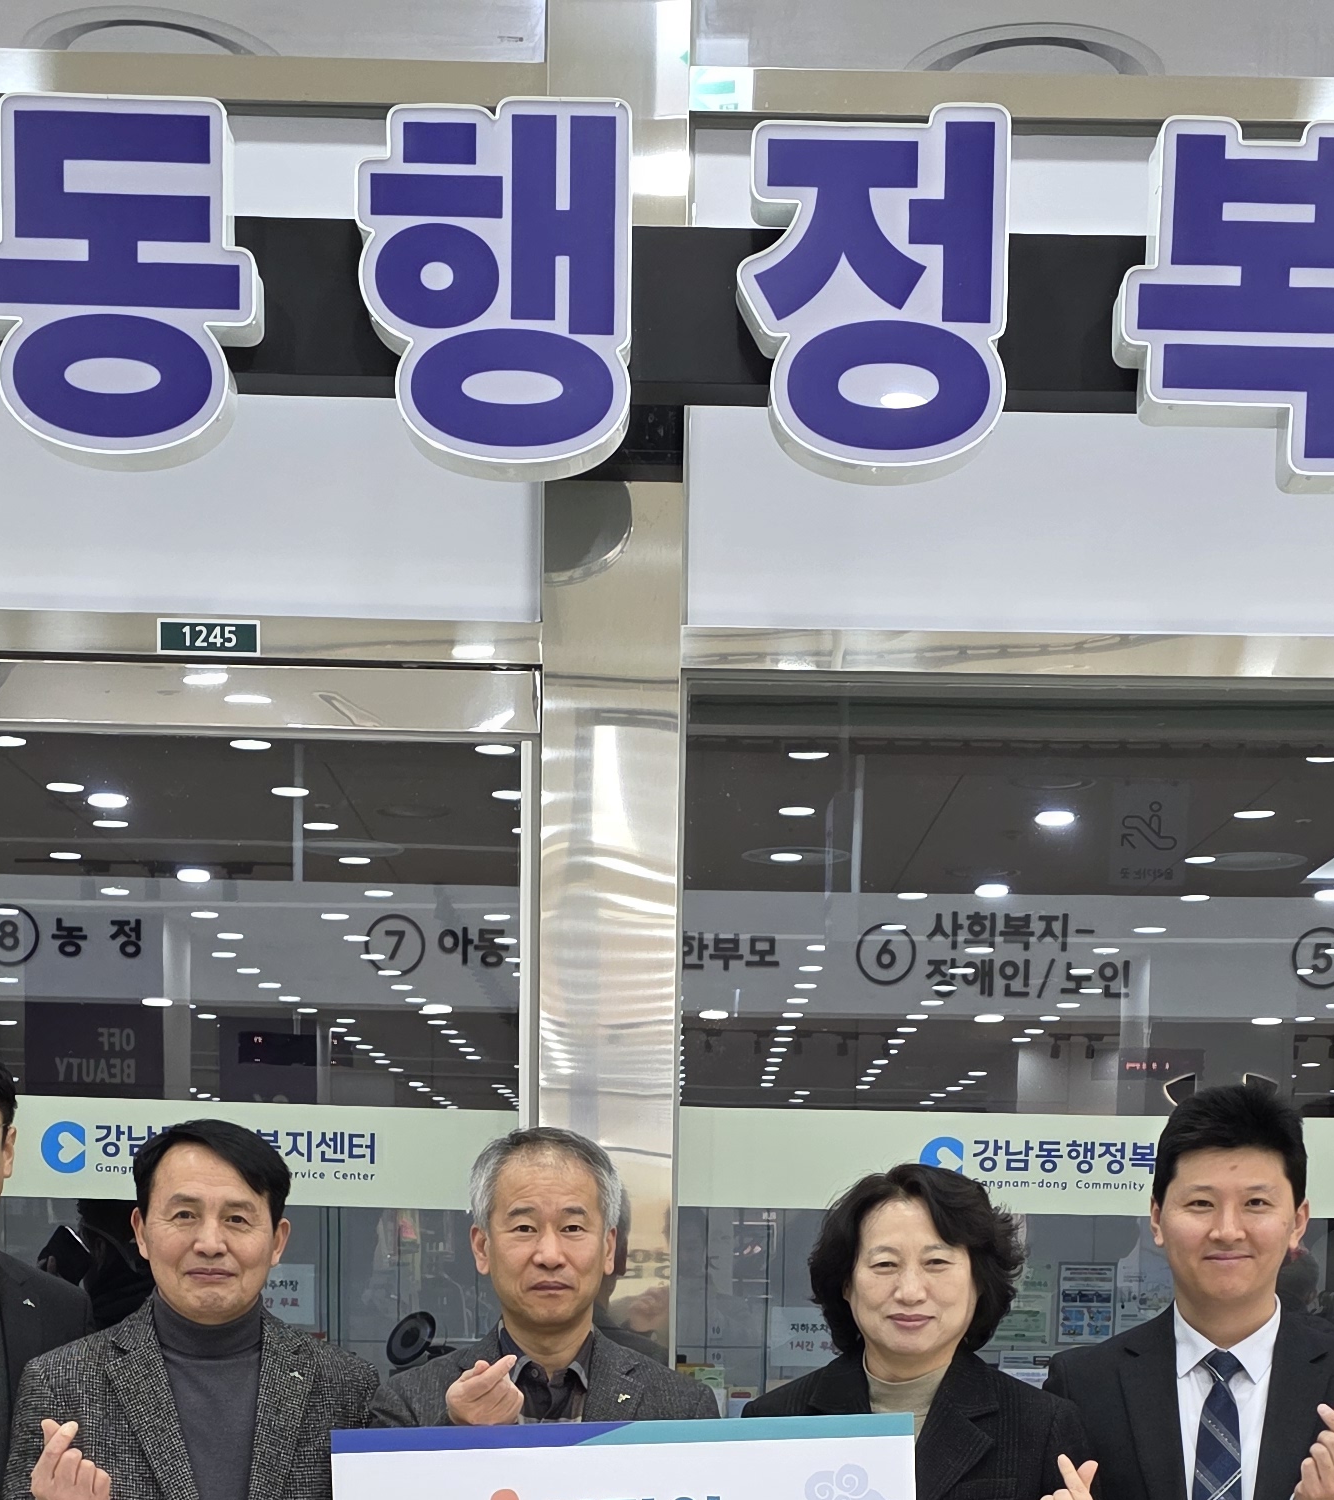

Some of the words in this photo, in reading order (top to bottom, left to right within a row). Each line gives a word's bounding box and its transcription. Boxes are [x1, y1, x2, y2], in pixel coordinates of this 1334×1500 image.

[181, 626, 238, 648] 1245
[333, 1170, 376, 1181] Center
[1075, 1179, 1145, 1192] Community
